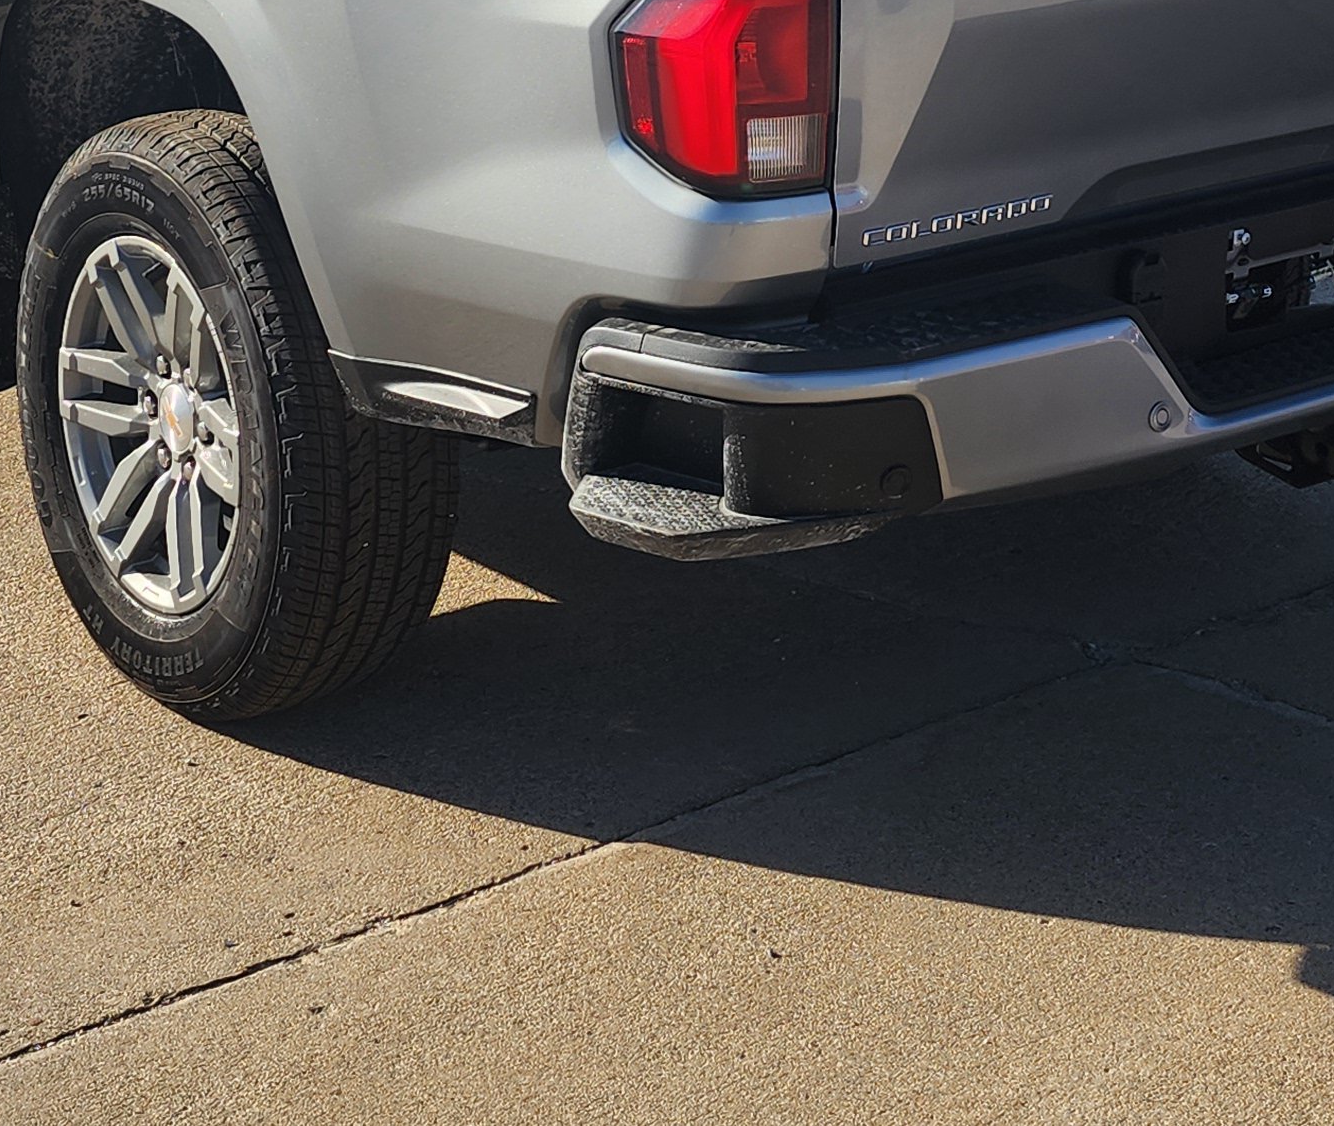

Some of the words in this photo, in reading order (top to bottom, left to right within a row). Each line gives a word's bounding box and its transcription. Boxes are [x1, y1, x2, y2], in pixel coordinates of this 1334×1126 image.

[82, 182, 155, 215] 255/65R17
[861, 192, 1054, 248] COLORADO
[109, 636, 204, 677] TERRITORY
